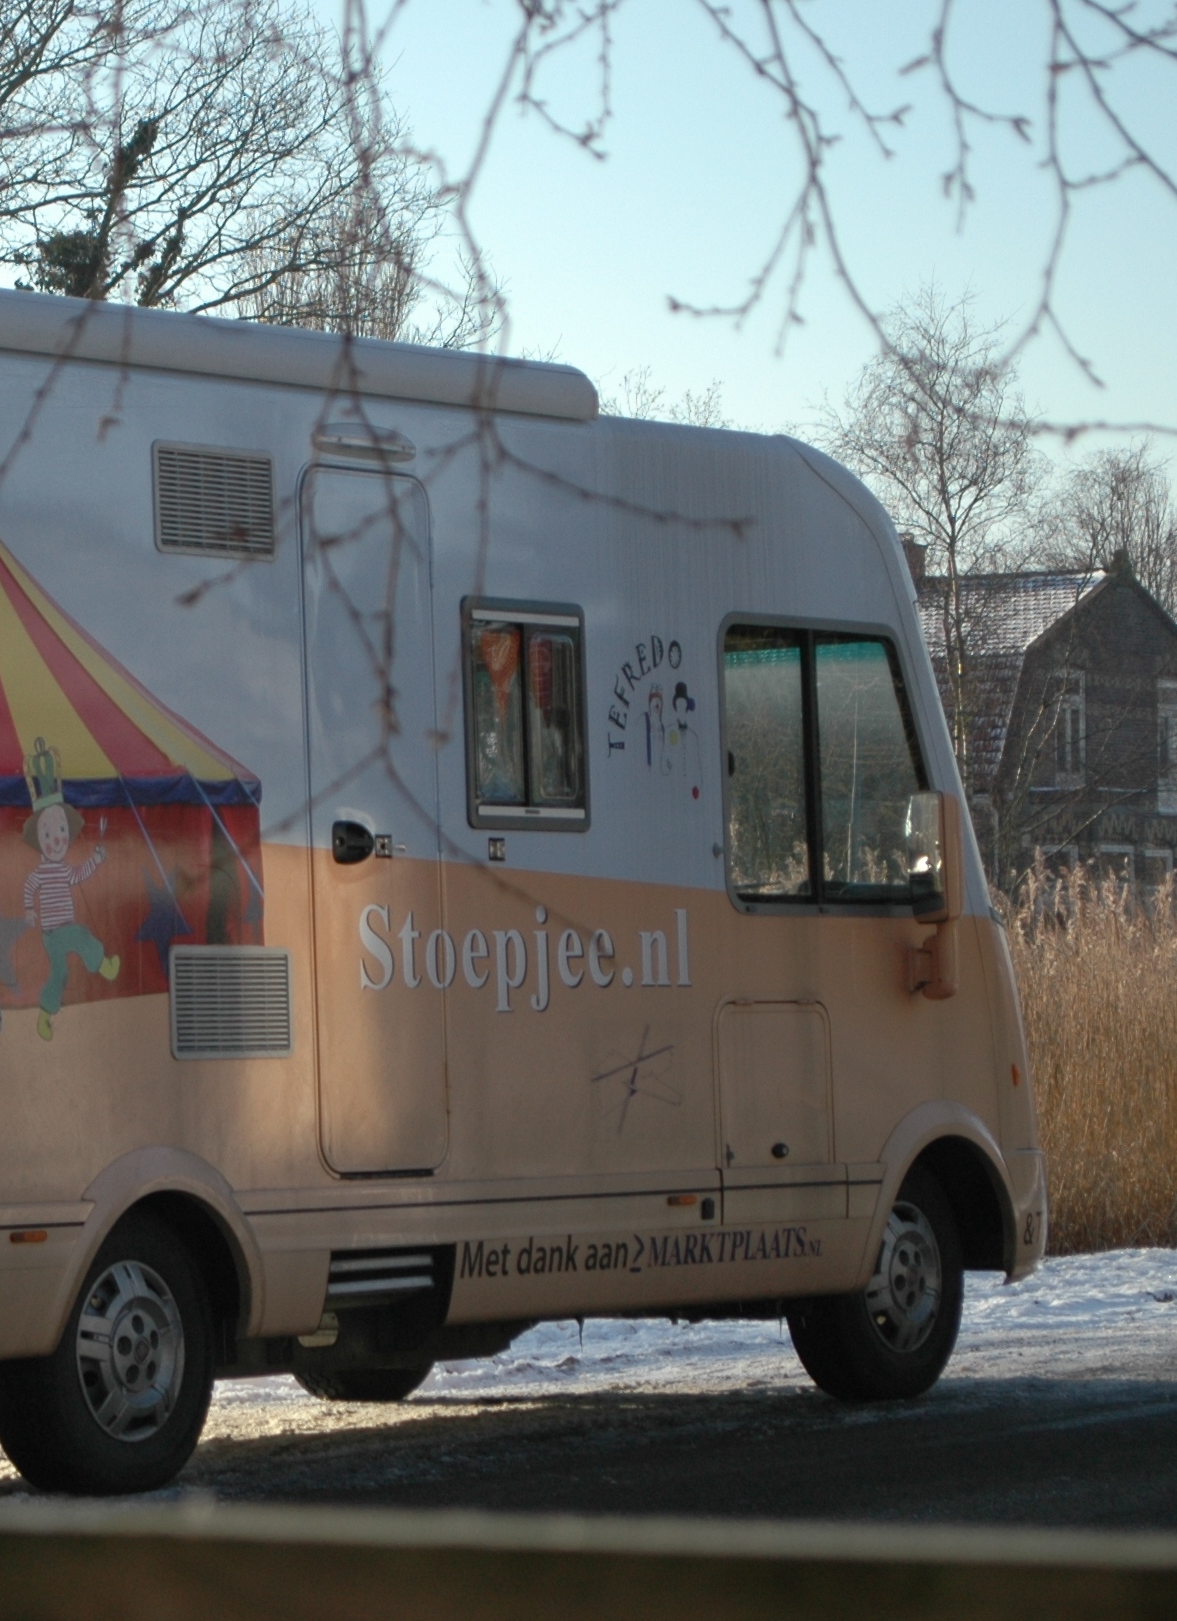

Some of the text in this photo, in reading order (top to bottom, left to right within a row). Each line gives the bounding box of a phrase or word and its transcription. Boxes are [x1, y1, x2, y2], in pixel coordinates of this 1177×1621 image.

[607, 635, 682, 758] TEFREDO
[358, 903, 693, 1013] Stoepjee.nl
[460, 1240, 511, 1279] Met
[517, 1234, 579, 1276] dank
[585, 1240, 629, 1272] aan
